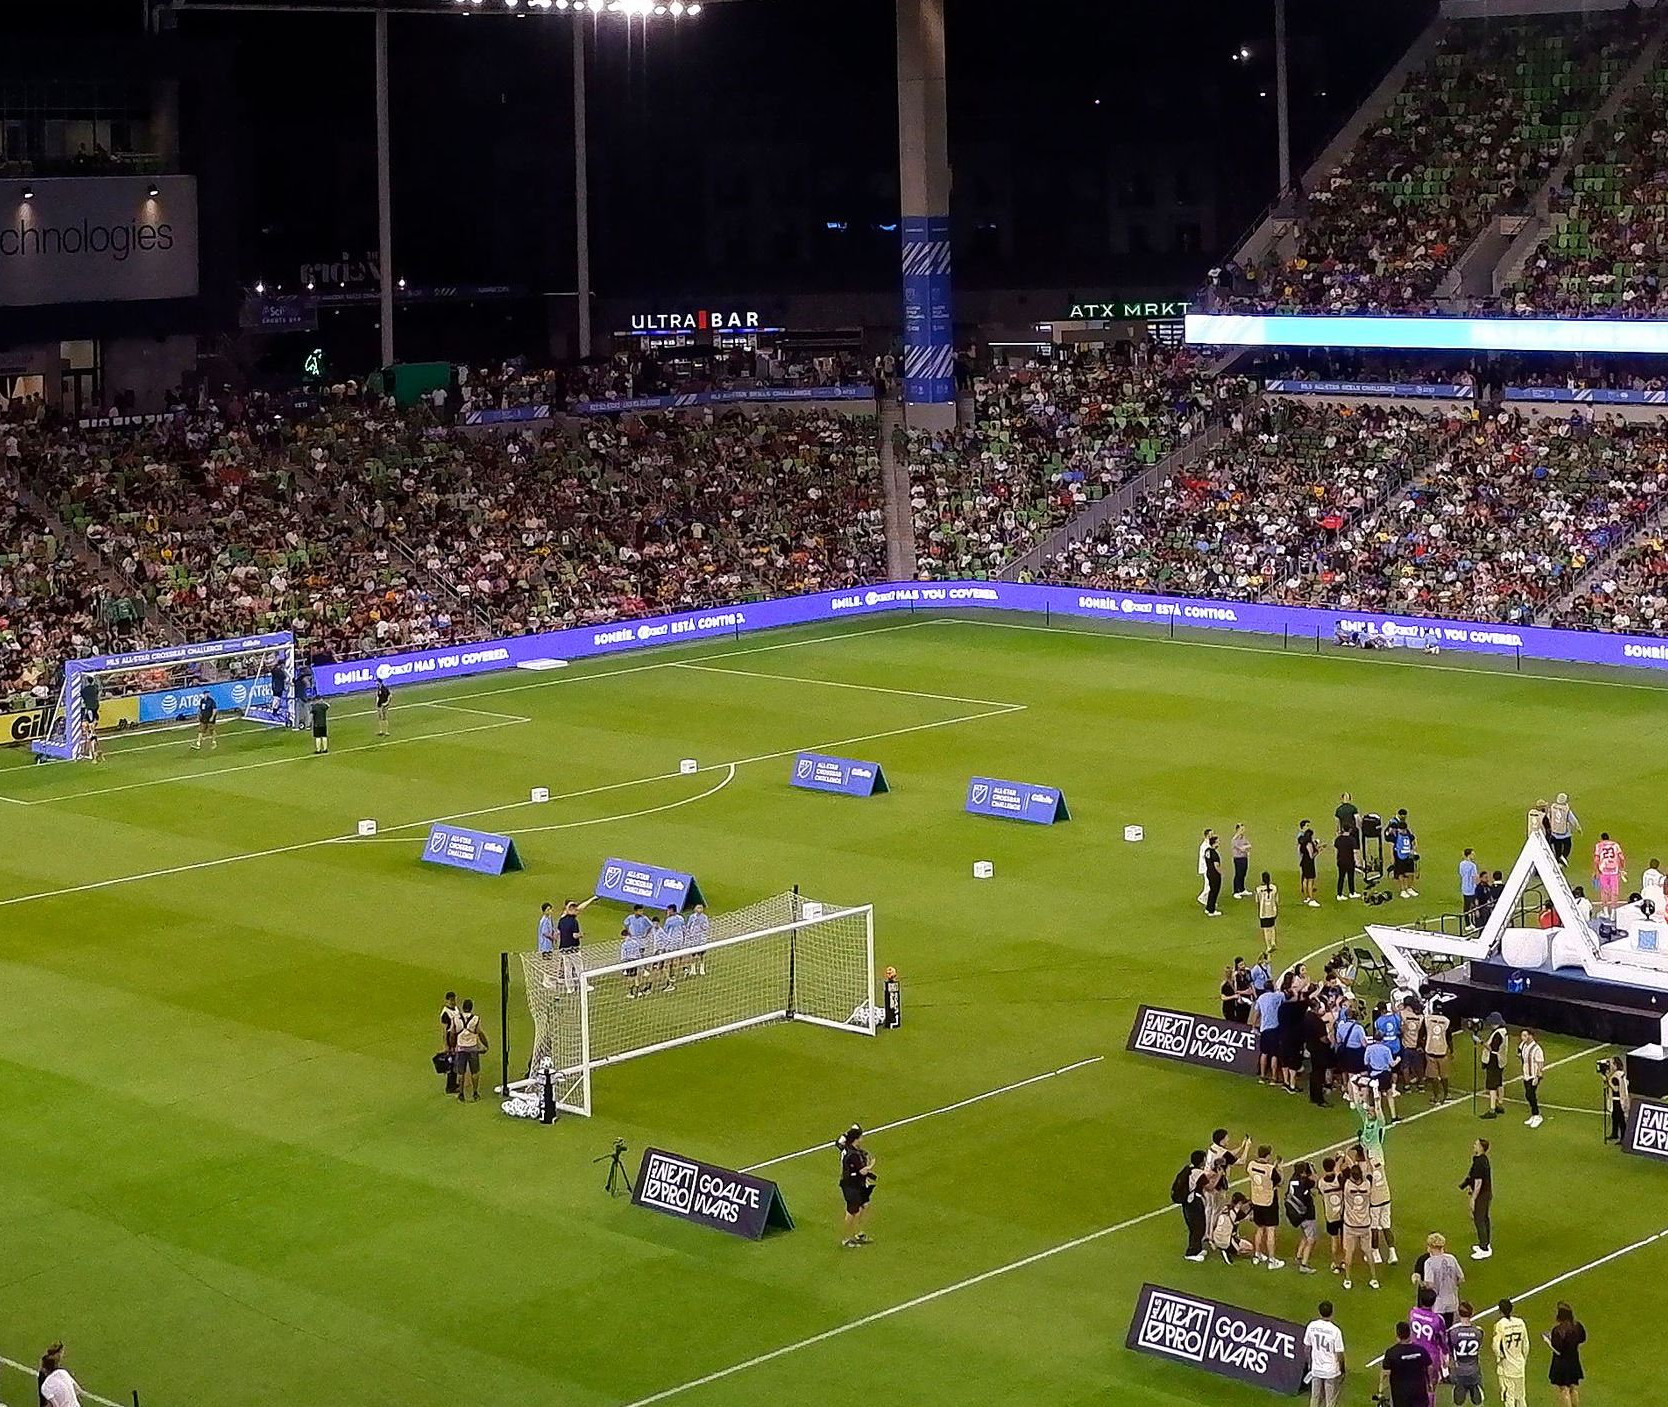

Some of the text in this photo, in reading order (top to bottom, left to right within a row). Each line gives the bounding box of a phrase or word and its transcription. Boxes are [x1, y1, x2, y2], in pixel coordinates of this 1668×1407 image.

[1070, 302, 1192, 317] ATX MRKT
[632, 312, 759, 328] ULTRA BAR
[921, 589, 946, 599] YOU
[1184, 606, 1237, 621] CONTIGO.
[1444, 628, 1467, 641] YOU
[188, 644, 223, 656] CHALLENGE
[334, 668, 373, 685] SMILE.
[414, 658, 435, 672] HAS
[438, 655, 460, 668] YOU
[461, 648, 509, 665] COVERED.
[1602, 847, 1614, 858] 23
[1152, 1016, 1189, 1035] NEXT
[1156, 1031, 1184, 1051] PRO
[1196, 1024, 1255, 1050] GOALIE
[1190, 1040, 1236, 1062] WARS
[656, 1163, 694, 1187] NEXT
[661, 1184, 689, 1206] PRO
[700, 1175, 760, 1209] GOALIE
[694, 1193, 739, 1223] WARS
[1160, 1302, 1208, 1330] NEXT
[1166, 1322, 1201, 1352] PRO
[1215, 1317, 1296, 1359] GOALIE
[1412, 1321, 1433, 1341] 99
[1505, 1332, 1523, 1348] 77
[1314, 1334, 1331, 1352] 14
[1457, 1340, 1479, 1356] 12
[1208, 1337, 1269, 1374] WARS
